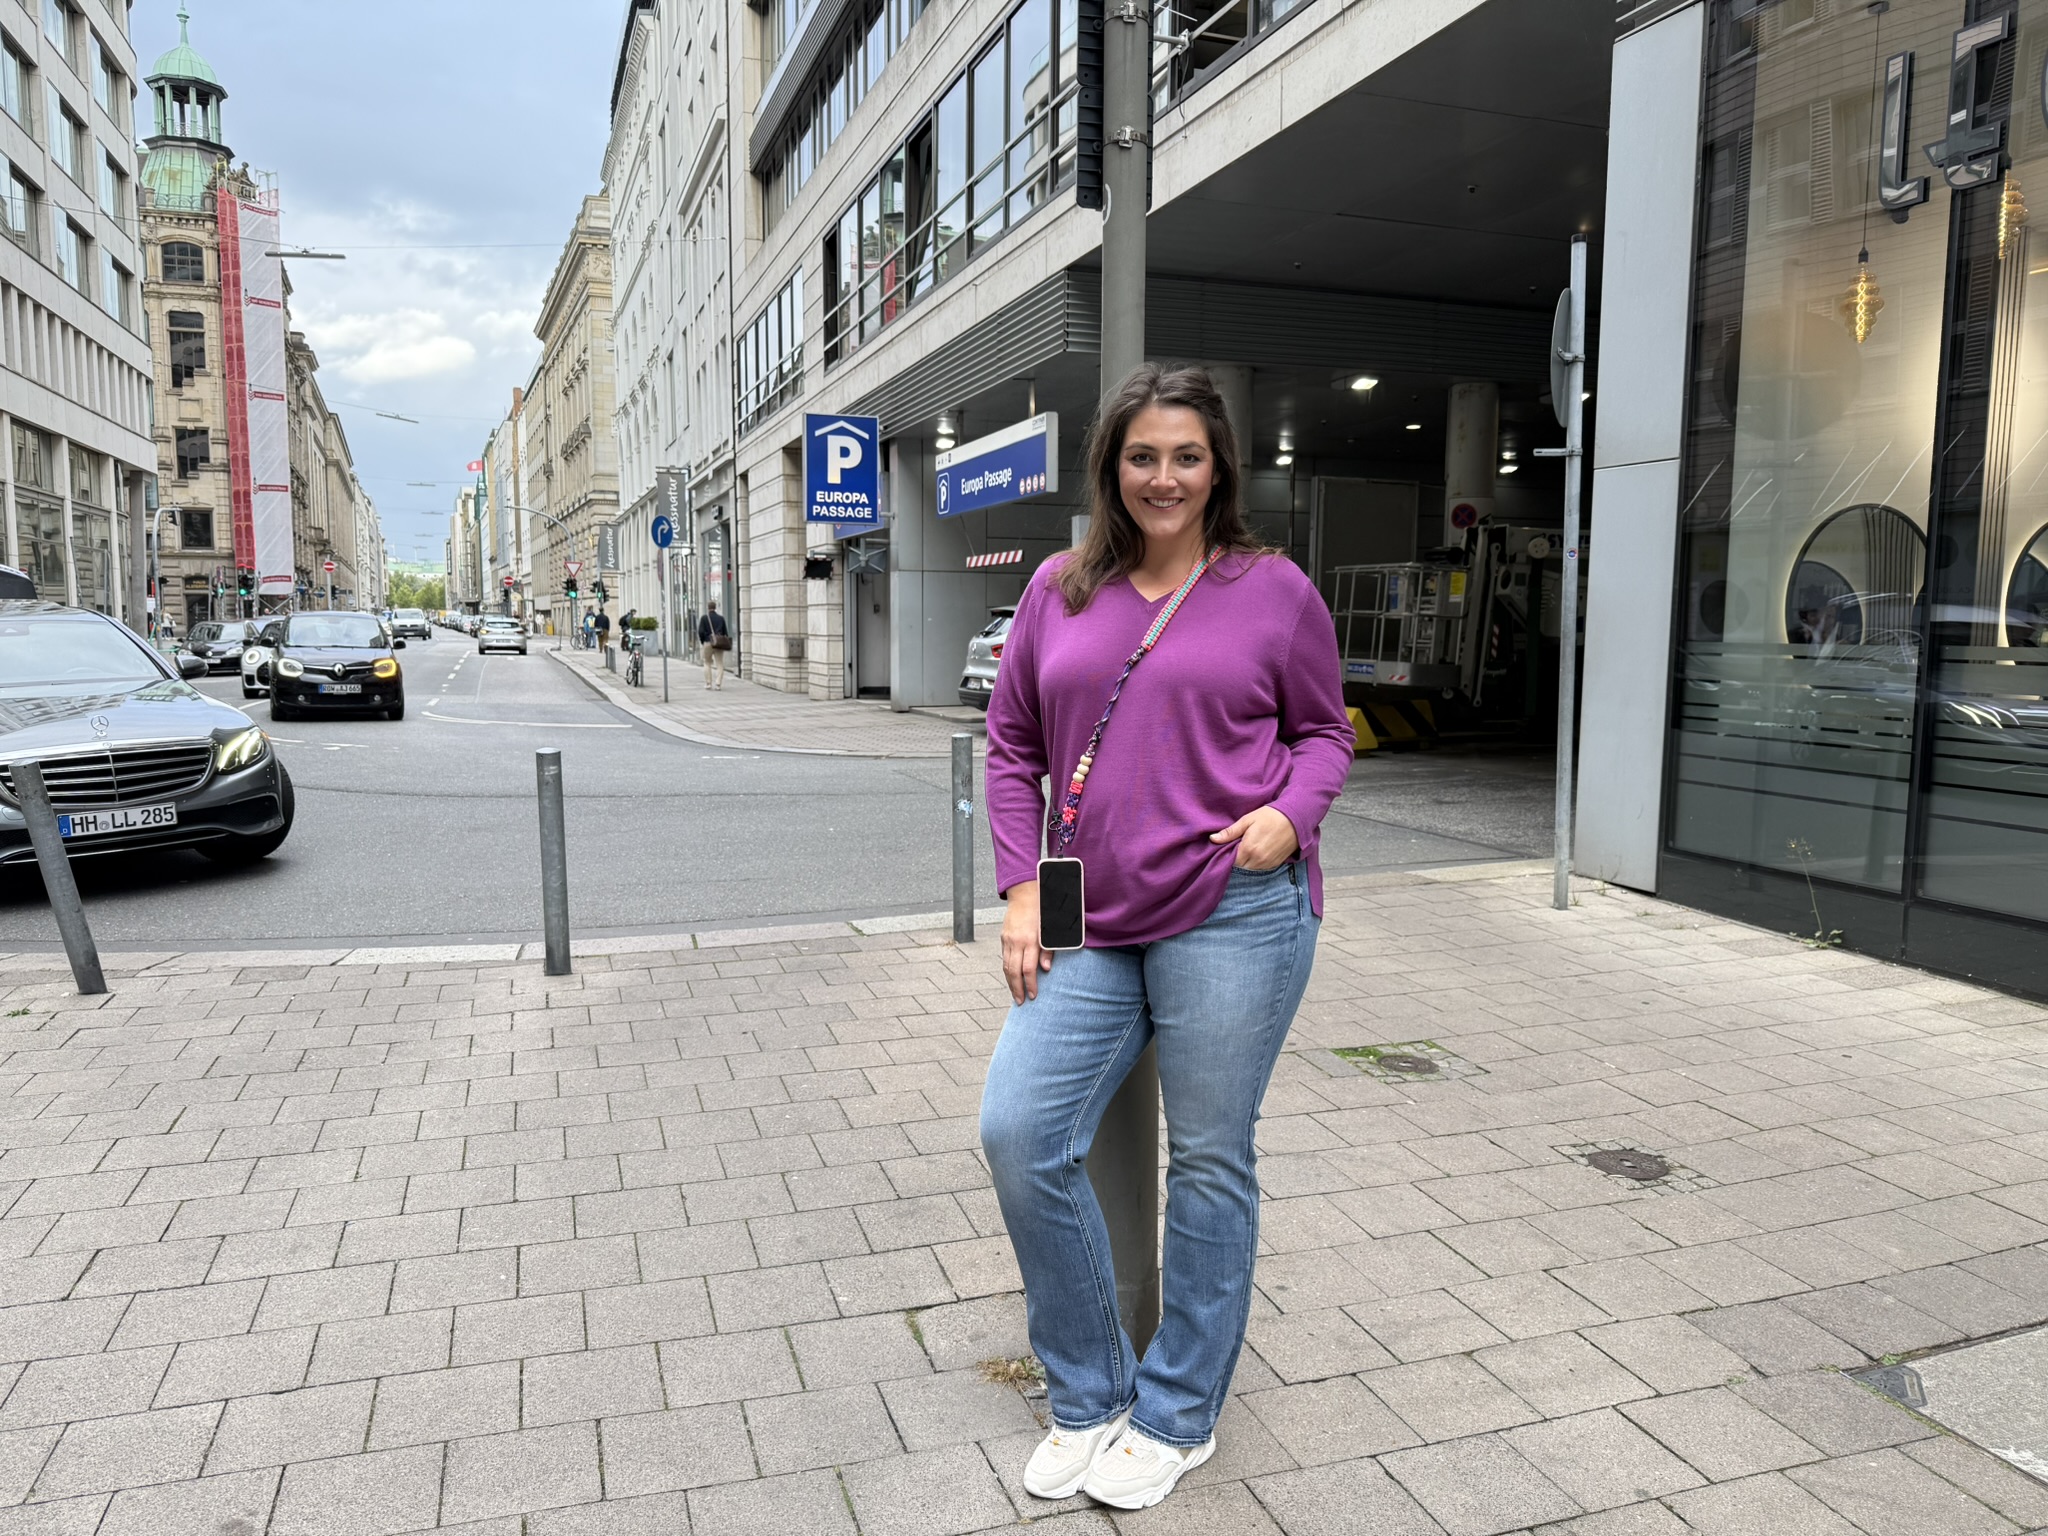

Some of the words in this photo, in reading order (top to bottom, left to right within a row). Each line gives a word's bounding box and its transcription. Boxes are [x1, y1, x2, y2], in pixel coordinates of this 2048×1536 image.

[827, 434, 863, 484] P
[961, 476, 984, 495] Europa
[984, 467, 1012, 488] Passage
[816, 490, 869, 504] EUROPA
[940, 485, 947, 510] P
[812, 505, 873, 518] PASSAGE
[605, 527, 615, 568] hessnatur
[71, 815, 98, 834] HH
[111, 811, 137, 830] LL
[141, 805, 175, 826] 285
